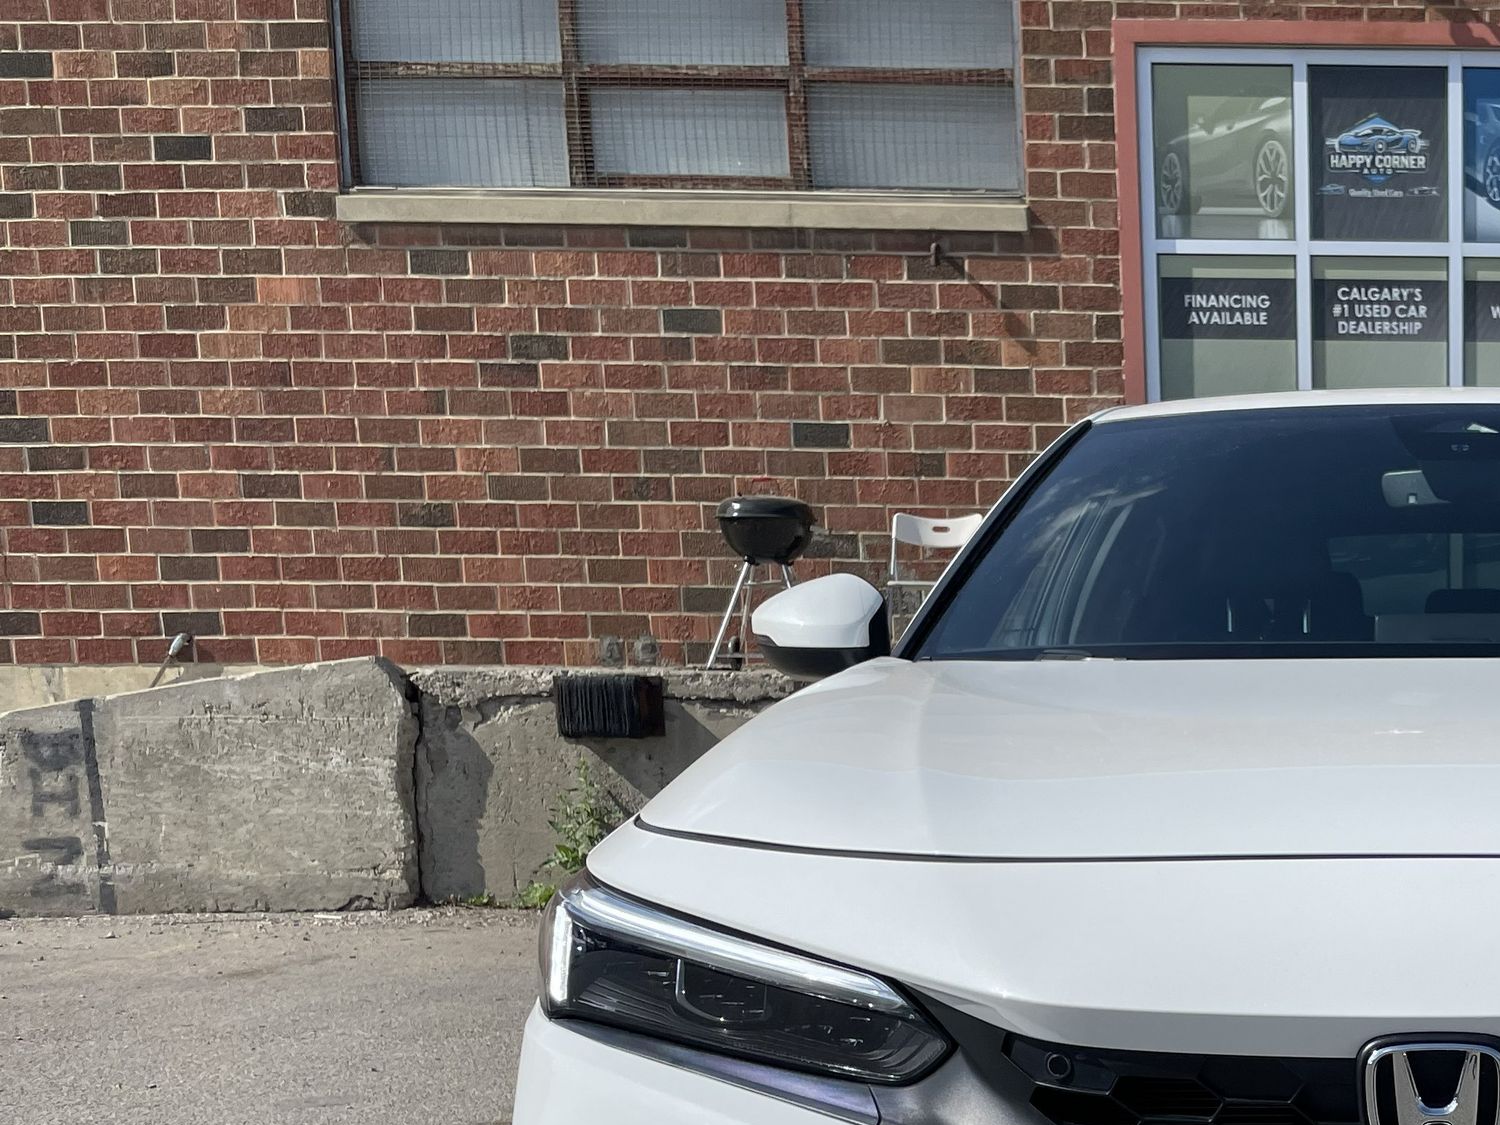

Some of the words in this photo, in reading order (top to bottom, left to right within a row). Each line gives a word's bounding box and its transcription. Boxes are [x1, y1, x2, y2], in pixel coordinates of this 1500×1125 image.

[1330, 154, 1373, 168] HAPPY
[1375, 155, 1426, 169] CORNER
[1184, 294, 1271, 309] FINANCING
[1337, 287, 1423, 302] CALGARY'S
[1187, 311, 1268, 325] AVAILABLE
[1332, 303, 1350, 318] #1
[1354, 304, 1392, 318] USED
[1394, 305, 1428, 318] CAR
[1337, 321, 1423, 335] DEALERSHIP
